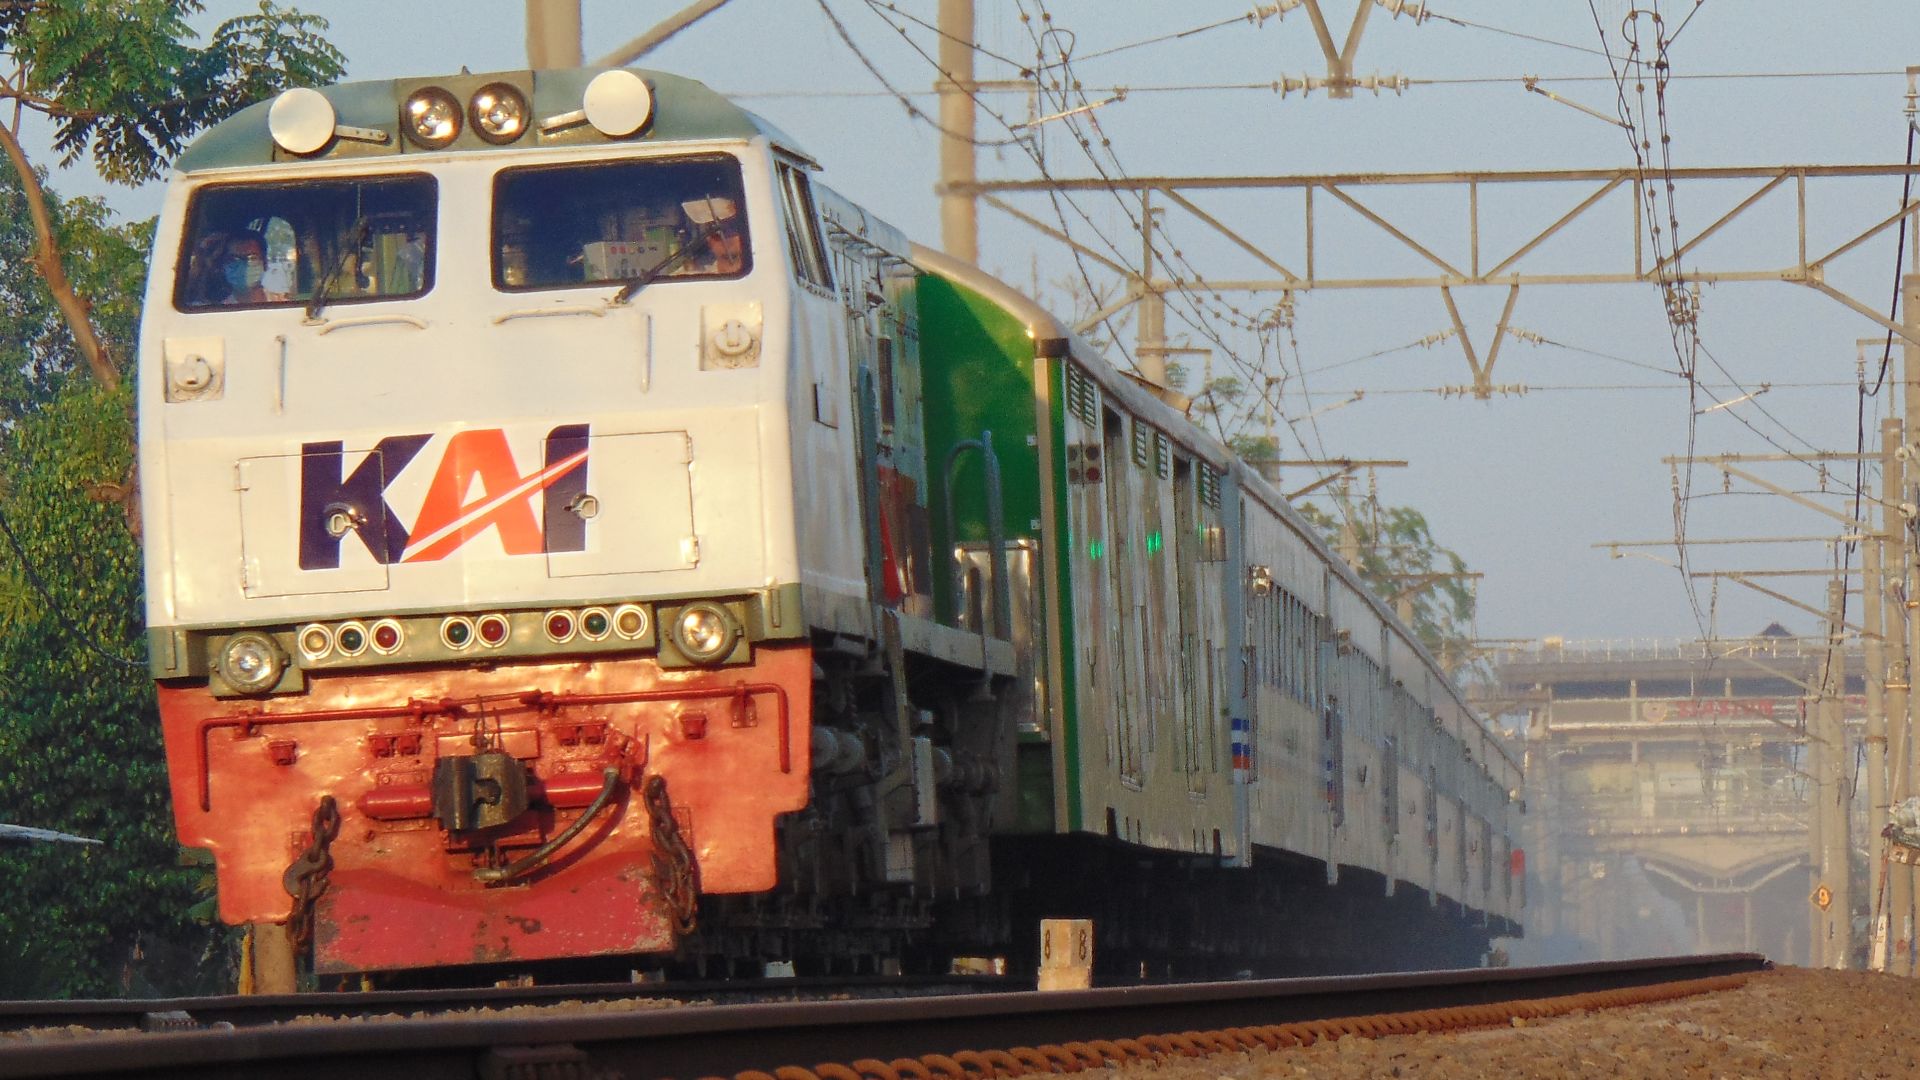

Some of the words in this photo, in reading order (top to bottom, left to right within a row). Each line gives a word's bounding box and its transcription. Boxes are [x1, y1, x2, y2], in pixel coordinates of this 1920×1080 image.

[299, 423, 590, 570] KAI
[1044, 929, 1051, 960] 8
[1079, 928, 1087, 960] 8
